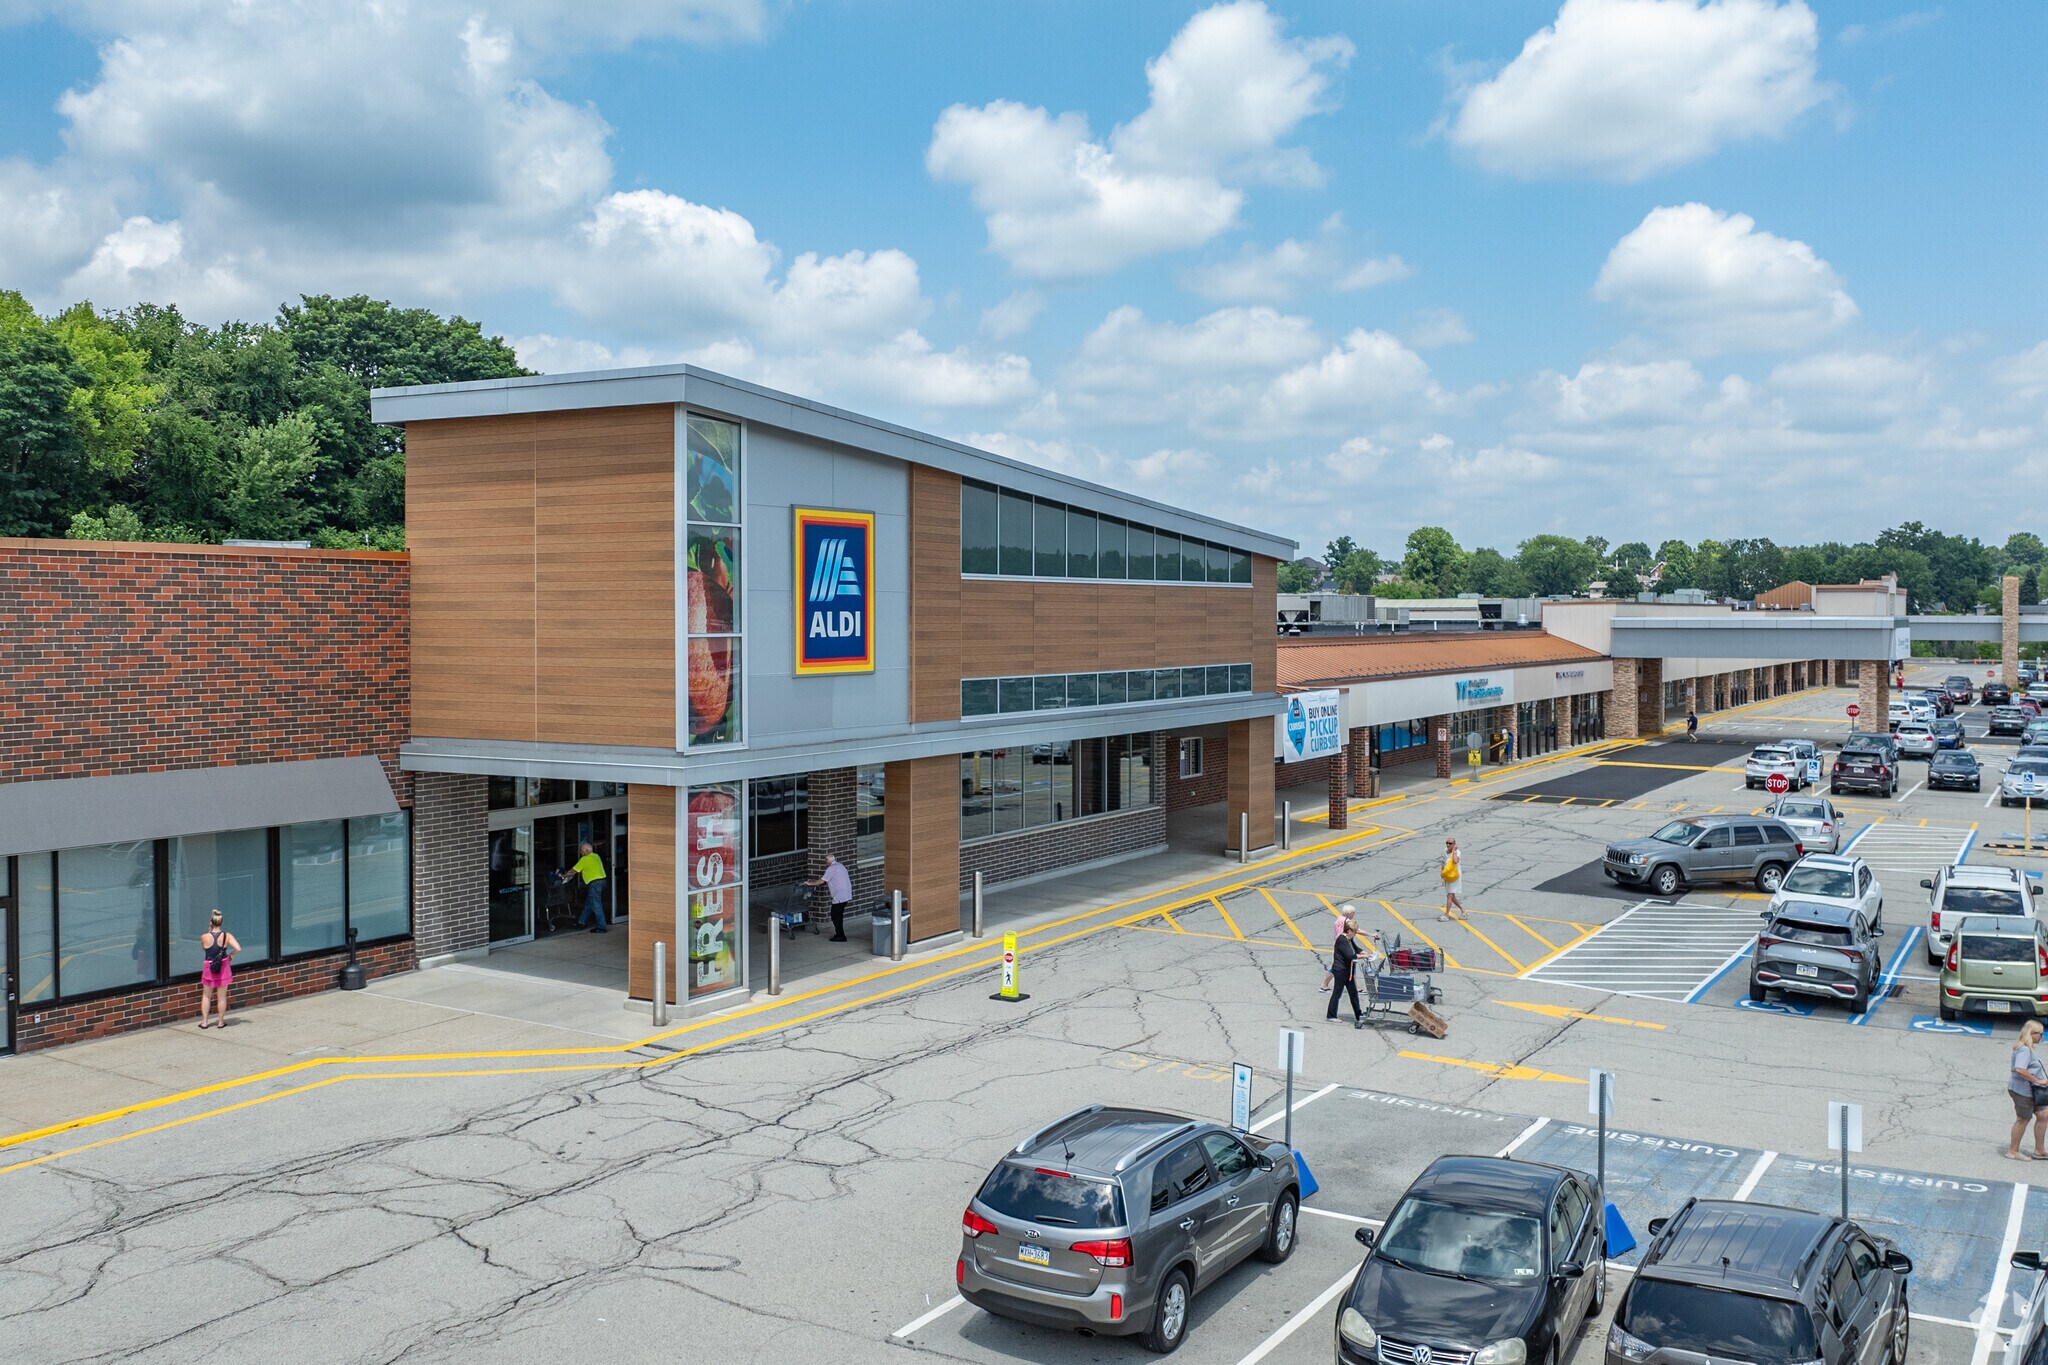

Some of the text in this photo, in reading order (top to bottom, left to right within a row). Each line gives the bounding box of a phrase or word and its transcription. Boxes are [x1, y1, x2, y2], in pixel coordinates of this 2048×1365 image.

[809, 610, 861, 638] ALDI
[1308, 704, 1338, 719] BUY ONLINE
[1309, 717, 1339, 738] PICKUP
[1767, 778, 1788, 789] STOP
[696, 812, 725, 988] FRESH
[1565, 1125, 1740, 1158] CURBSIDE
[1792, 1160, 1989, 1193] CURBSIDE
